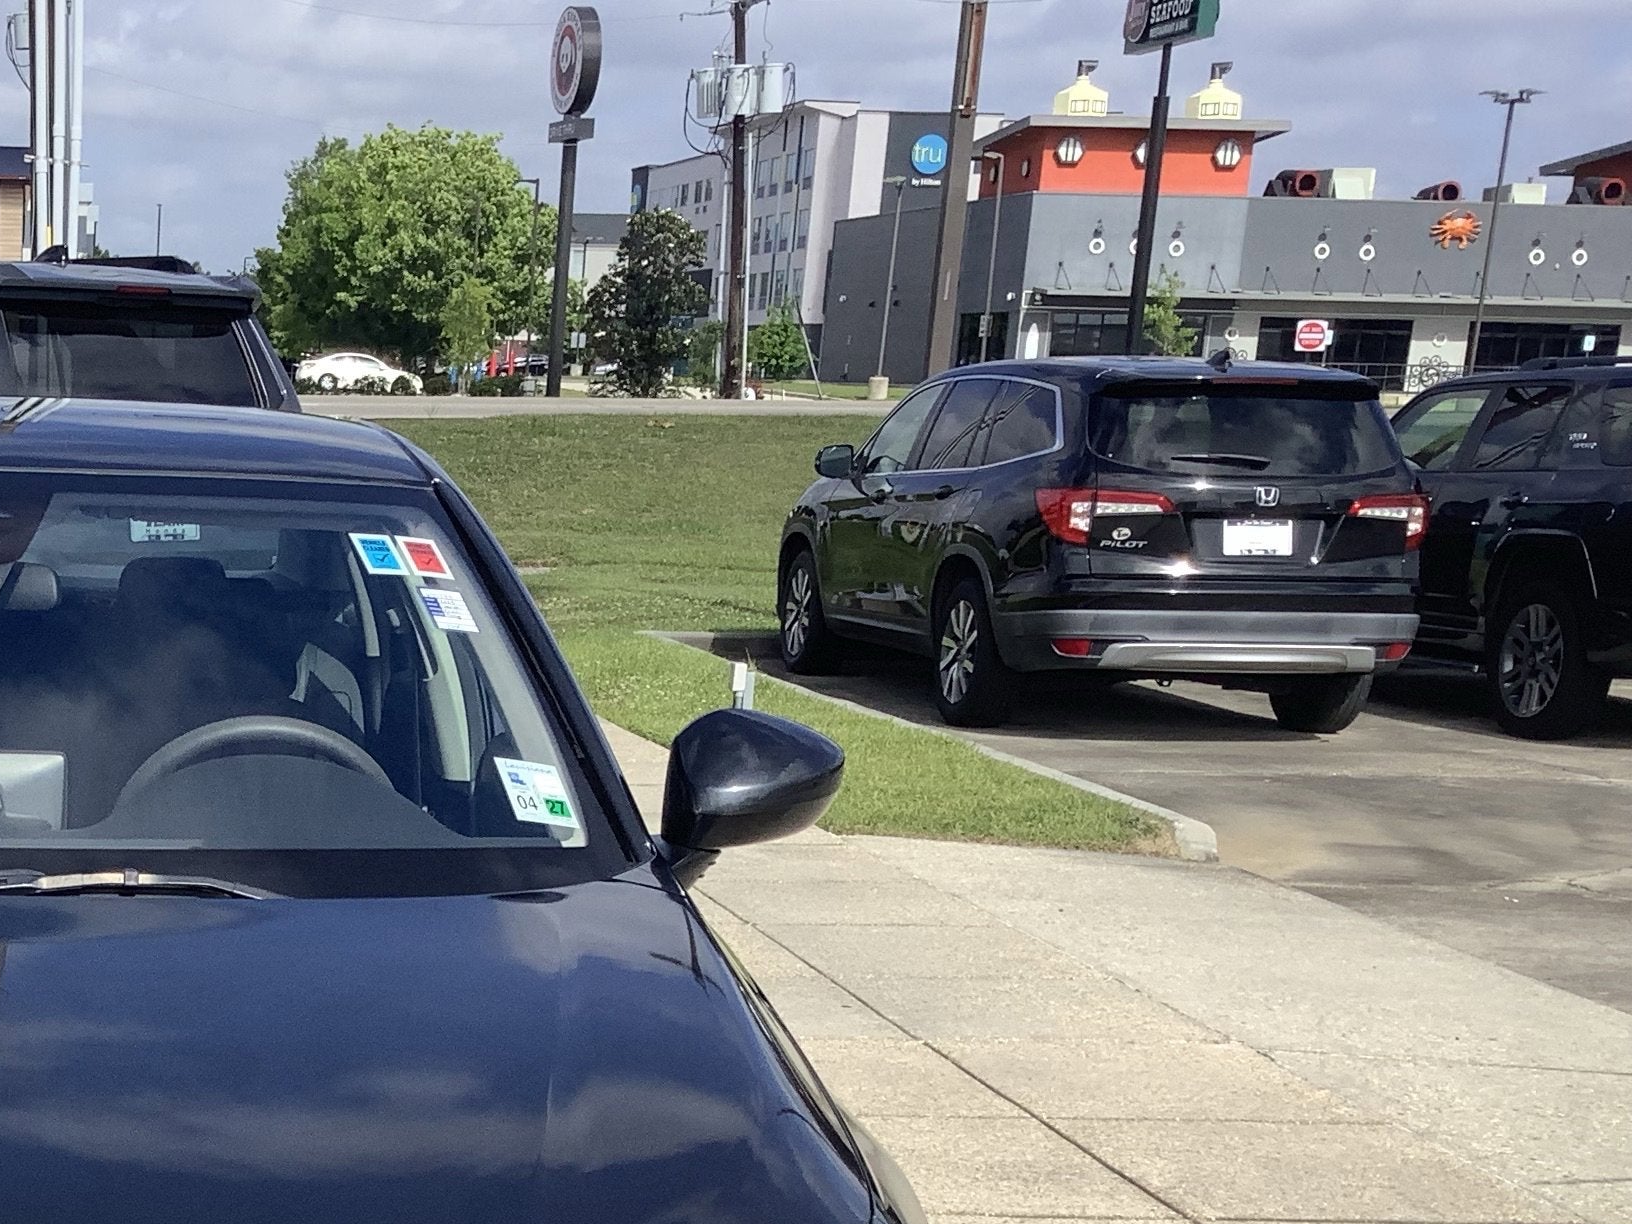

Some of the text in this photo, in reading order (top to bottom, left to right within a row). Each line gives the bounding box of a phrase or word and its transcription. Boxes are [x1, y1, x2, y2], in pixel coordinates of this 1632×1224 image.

[1149, 0, 1193, 24] SEAFOOD
[914, 144, 942, 163] tru
[1100, 540, 1148, 548] PILOT
[517, 795, 565, 815] 04 27
